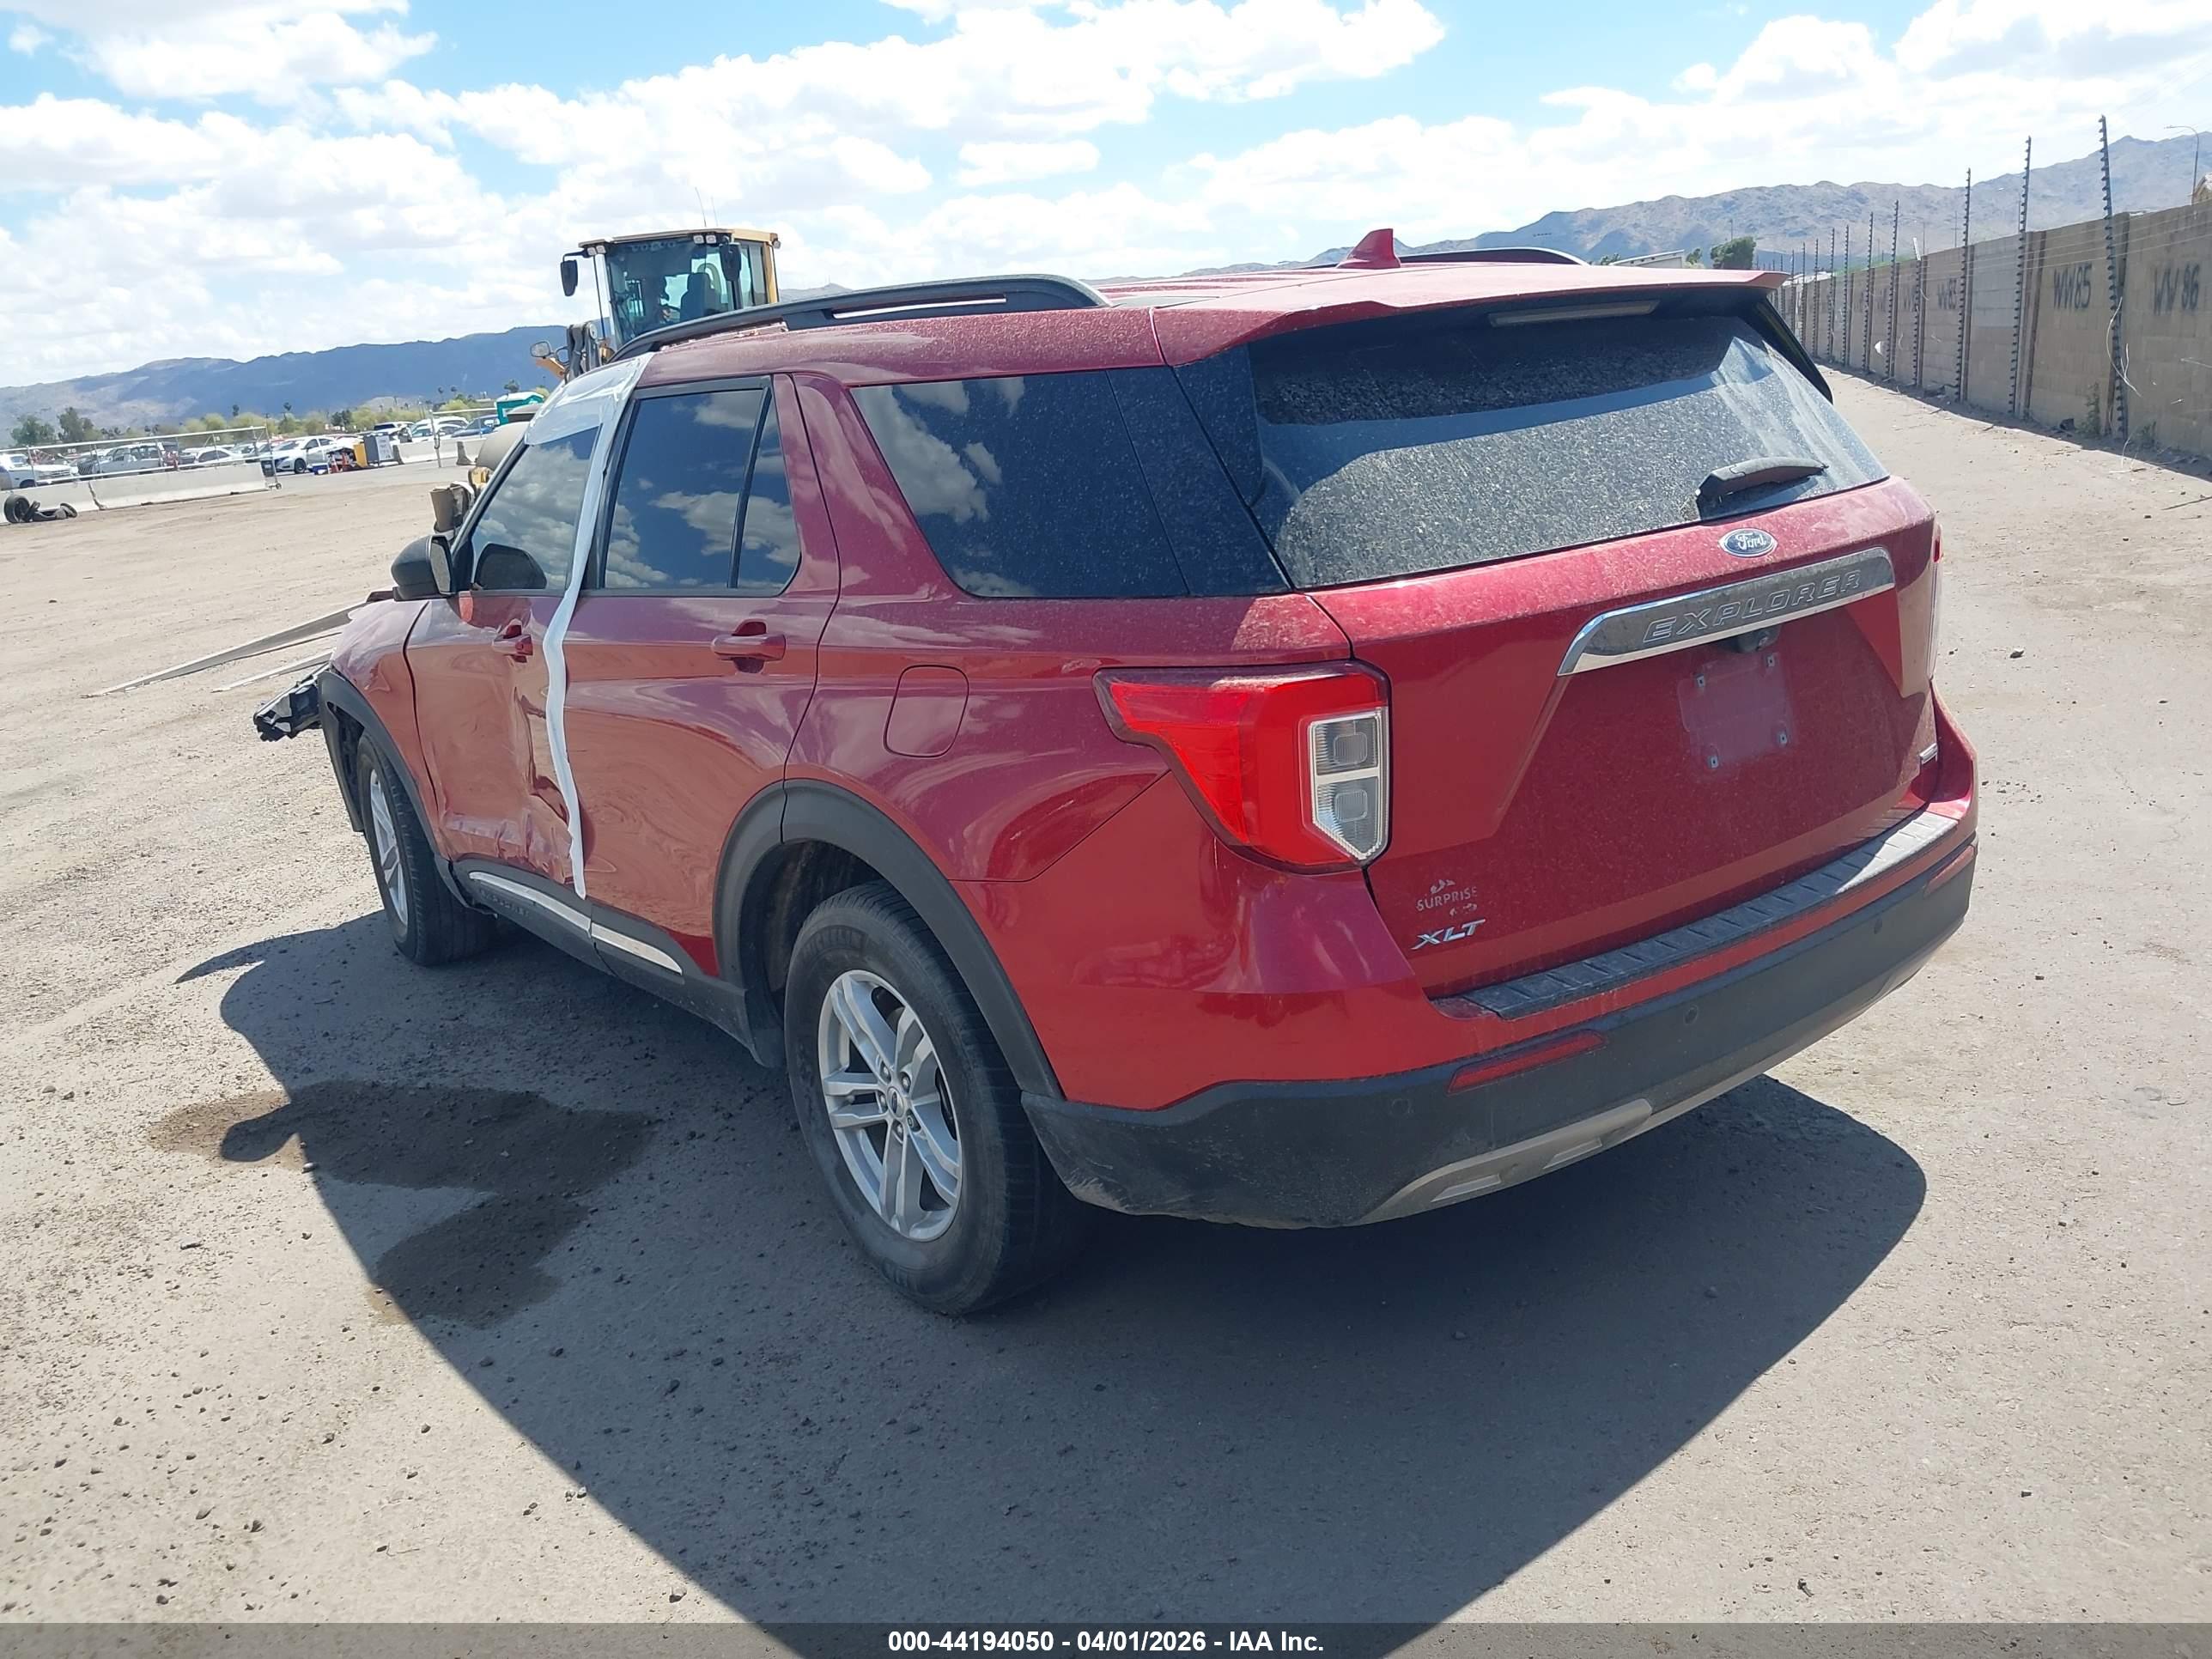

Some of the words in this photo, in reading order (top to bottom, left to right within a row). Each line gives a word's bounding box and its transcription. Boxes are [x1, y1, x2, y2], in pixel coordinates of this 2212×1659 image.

[1735, 532, 1766, 550] Ford
[1643, 568, 1862, 643] EXPLORER
[1415, 886, 1478, 912] SURPRISE
[1411, 918, 1486, 951] XLT
